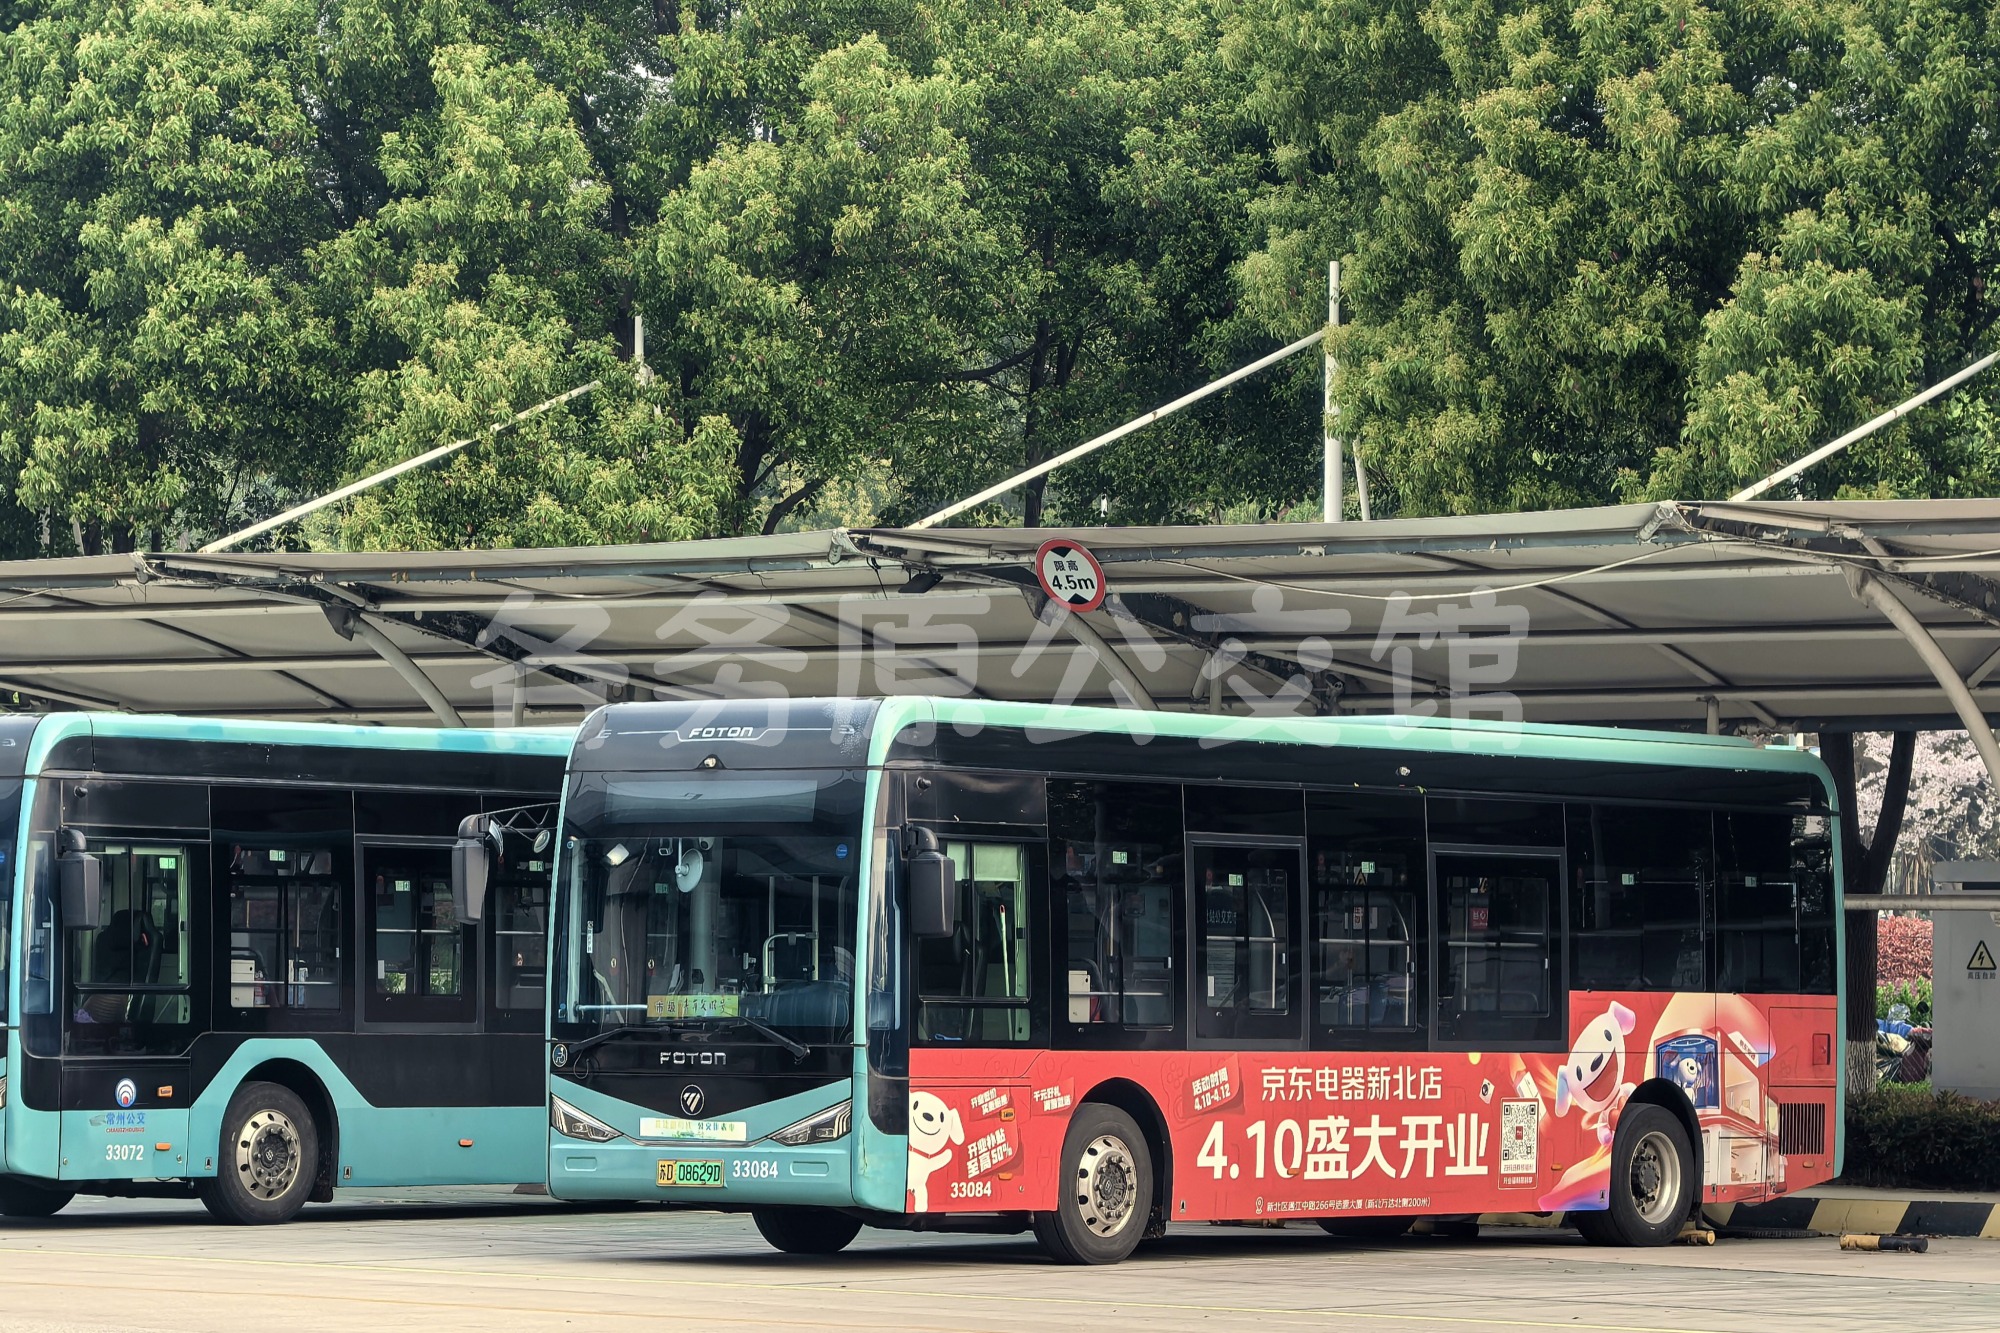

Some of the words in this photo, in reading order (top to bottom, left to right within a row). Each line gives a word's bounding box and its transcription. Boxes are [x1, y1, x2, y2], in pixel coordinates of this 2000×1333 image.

[1053, 560, 1079, 572] 限高
[1052, 574, 1096, 590] 4.5m
[688, 726, 754, 739] FOTON
[660, 1051, 727, 1065] FOTON
[1191, 1066, 1228, 1096] 活动时间
[1260, 1065, 1443, 1102] 京东电器新北店
[1194, 1083, 1231, 1111] 4.10-4.12
[105, 1111, 146, 1125] 常州公交
[105, 1144, 145, 1161] 33072
[967, 1127, 1006, 1160] 开业补贴
[1196, 1112, 1490, 1180] 4.10盛大开业
[732, 1159, 779, 1178] 33084
[966, 1142, 1013, 1179] 至高50%
[950, 1181, 992, 1199] 33084
